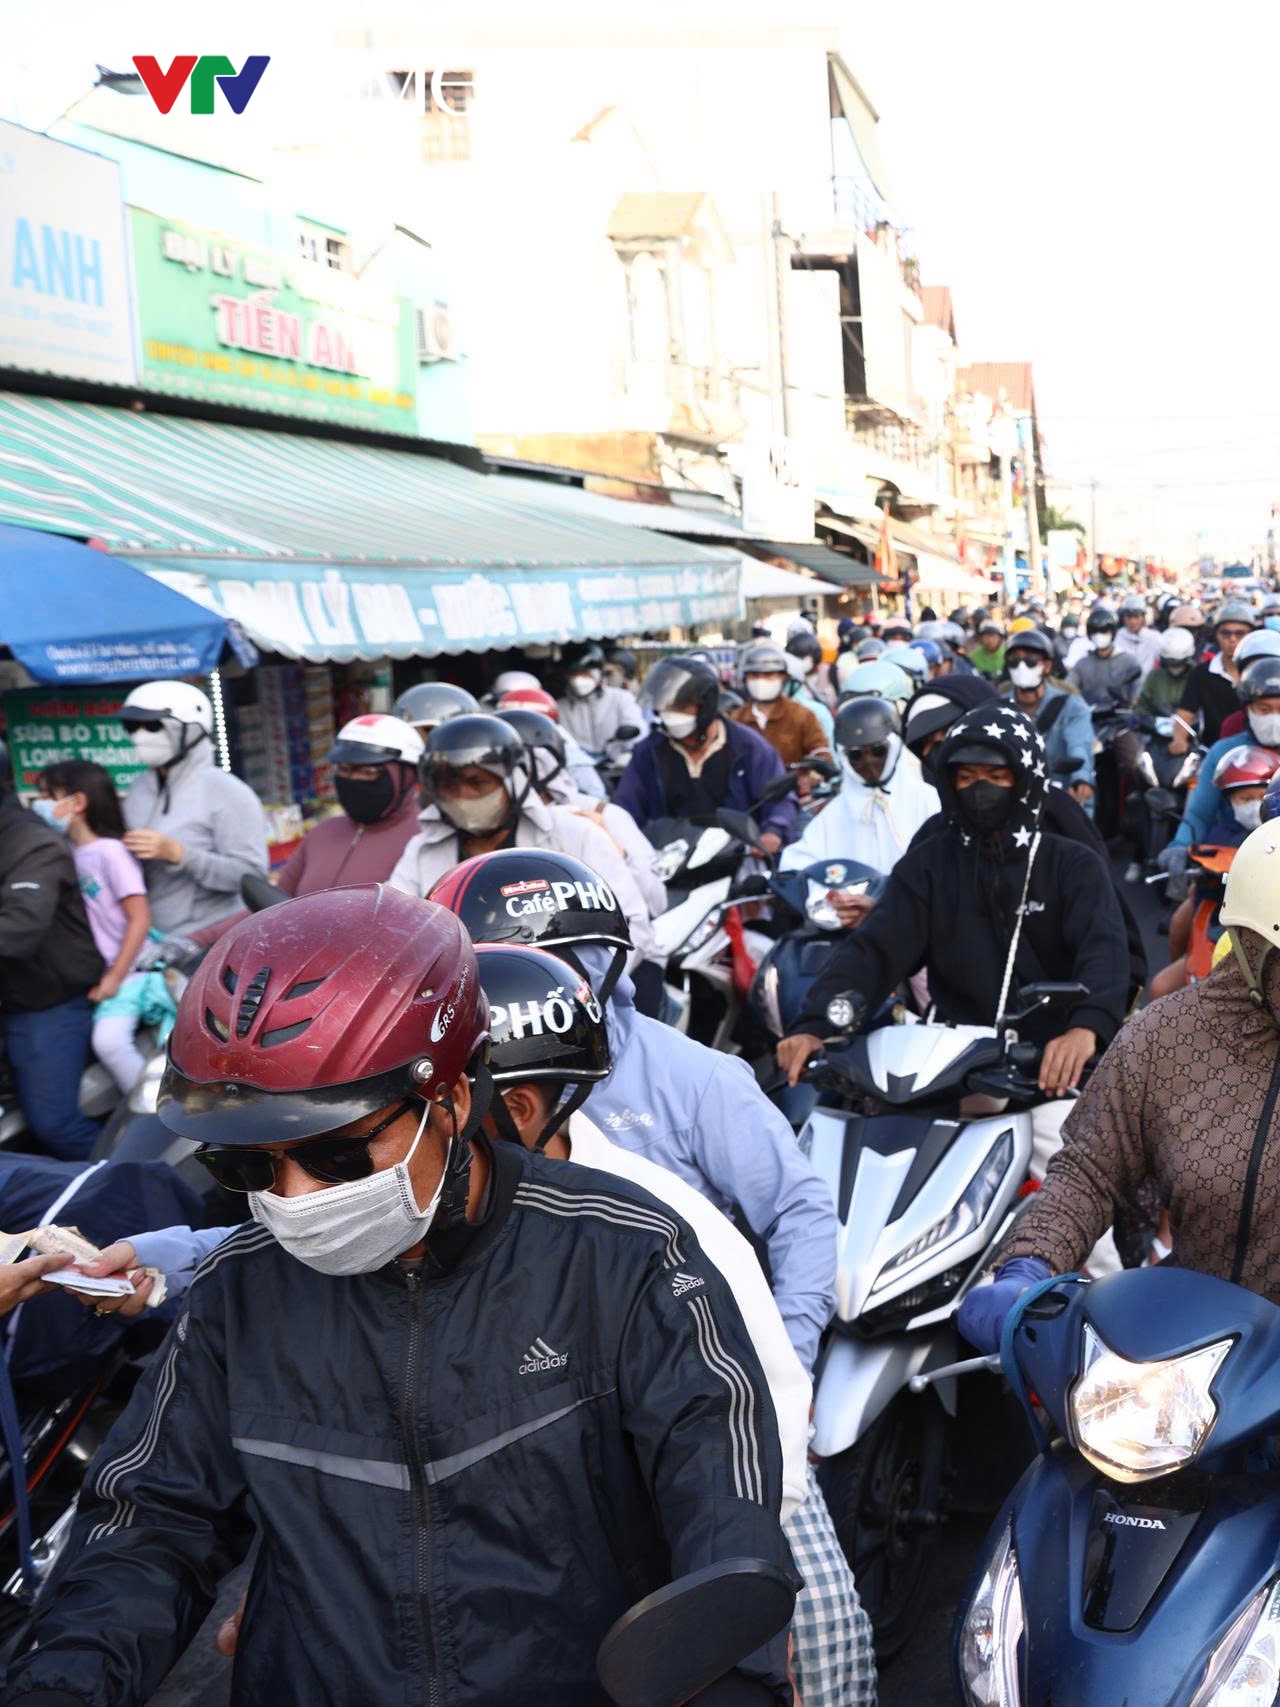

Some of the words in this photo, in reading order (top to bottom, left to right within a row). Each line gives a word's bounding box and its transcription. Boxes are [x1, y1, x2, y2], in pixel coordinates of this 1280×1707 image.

[12, 216, 104, 306] ANH
[505, 890, 558, 918] Café
[672, 1277, 705, 1297] adidas
[518, 1352, 569, 1375] adidas
[1103, 1512, 1167, 1530] HONDA
